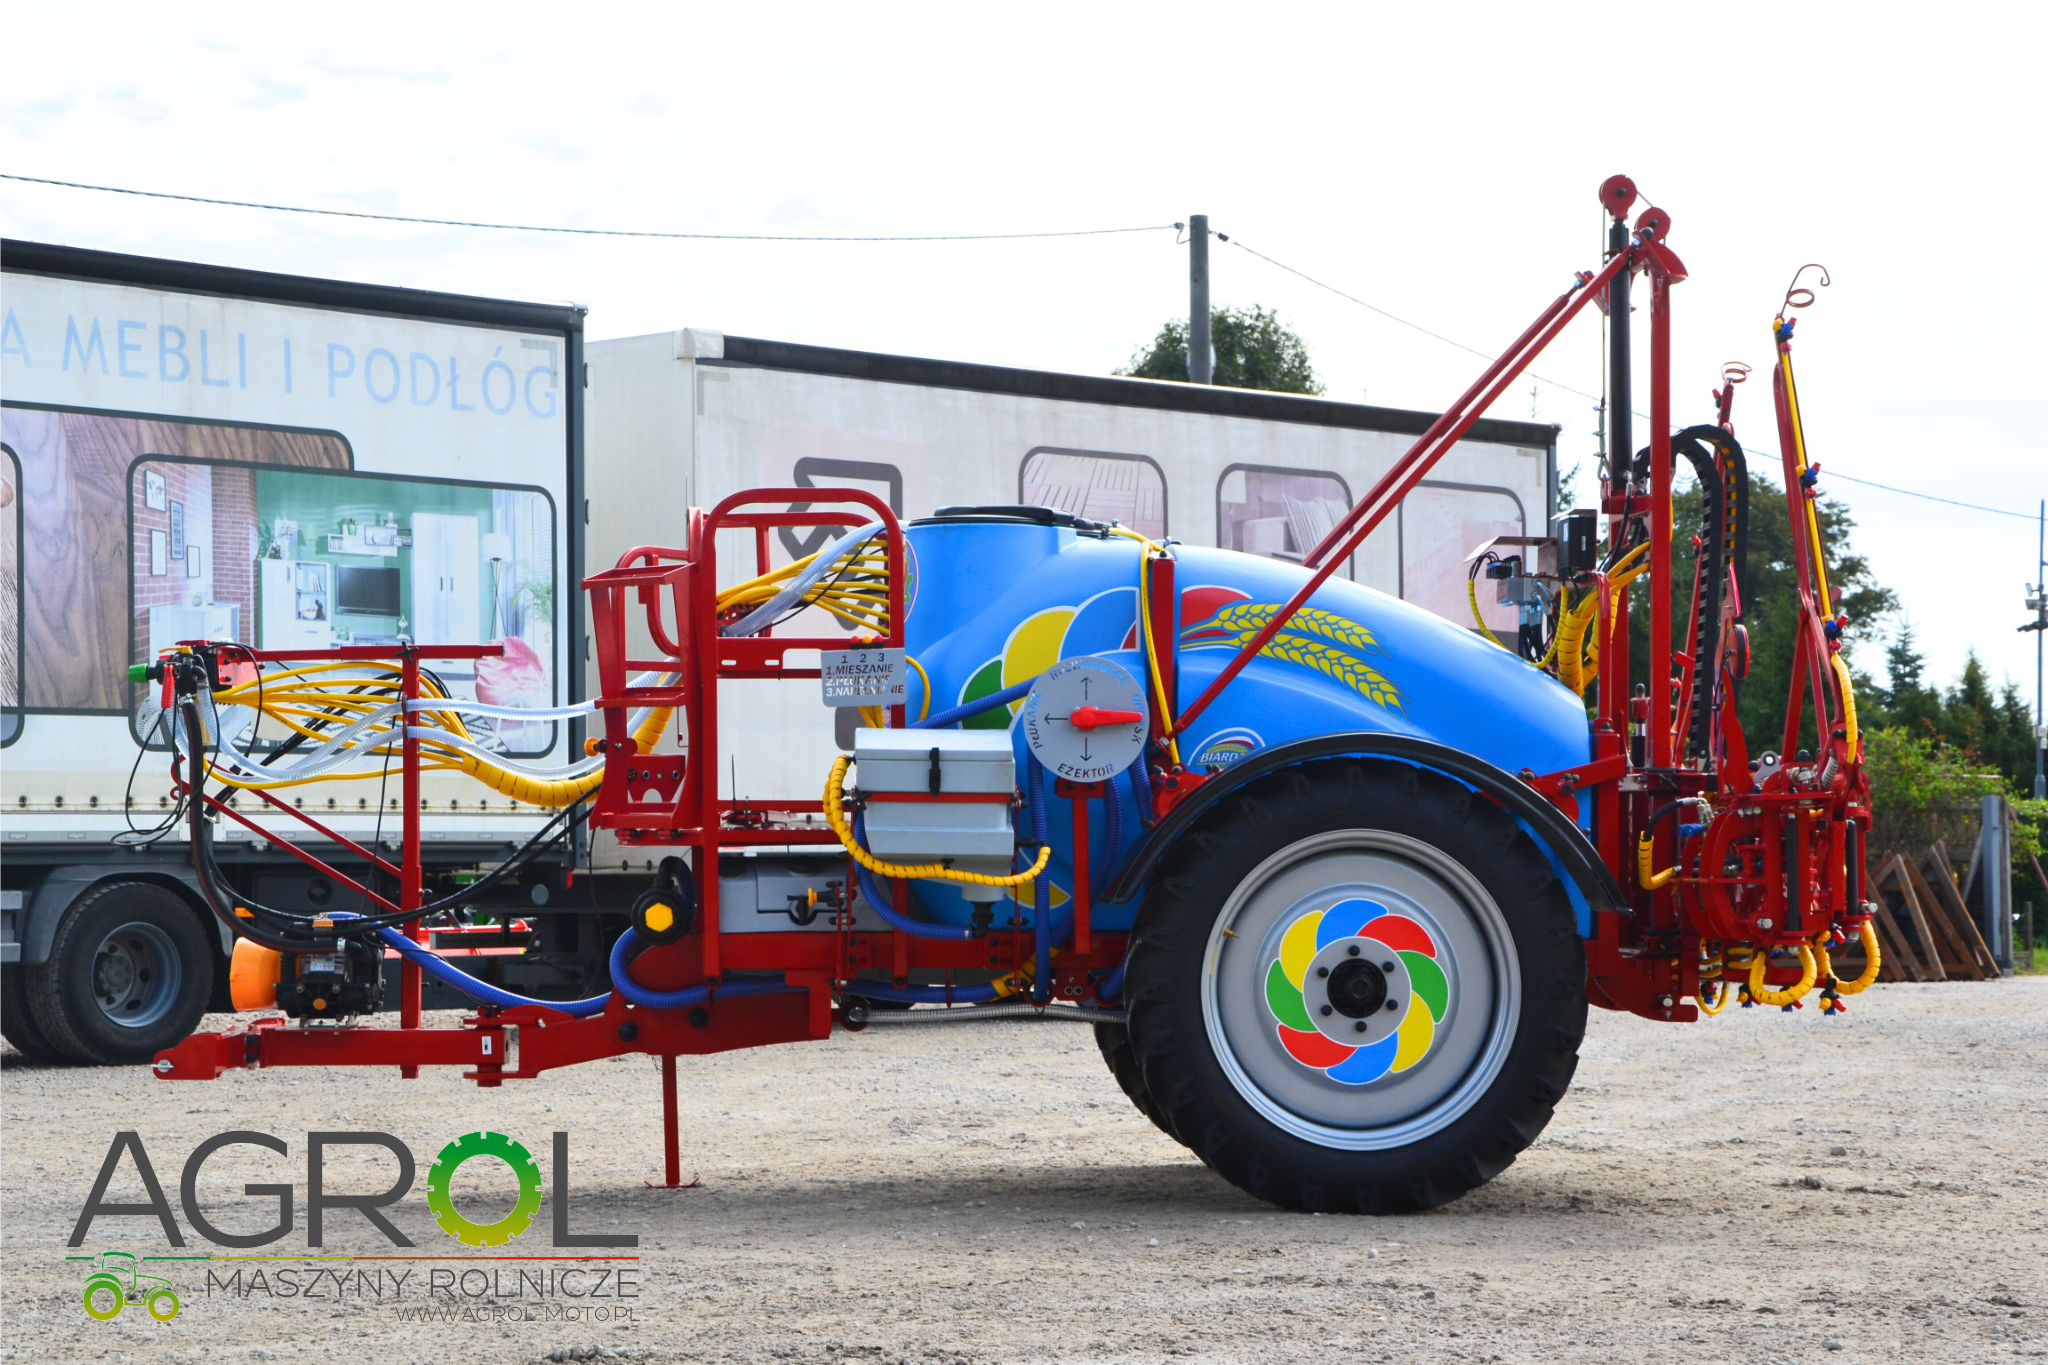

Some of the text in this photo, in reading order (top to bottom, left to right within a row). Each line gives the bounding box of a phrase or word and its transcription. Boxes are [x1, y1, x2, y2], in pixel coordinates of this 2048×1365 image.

[61, 313, 248, 390] MEBLI
[283, 337, 294, 395] I
[326, 342, 558, 420] PODŁÓG
[841, 652, 885, 664] 1 2 3
[825, 663, 894, 676] 1.MIESZANIE
[1049, 659, 1130, 685] ROZWADNIACZ
[825, 674, 890, 687] 2.PŁUKANIE
[825, 684, 905, 697] 3.NAPEŁNIANIE
[1027, 689, 1043, 750] PŁUKANIE
[1057, 762, 1115, 779] EŻEKTOR
